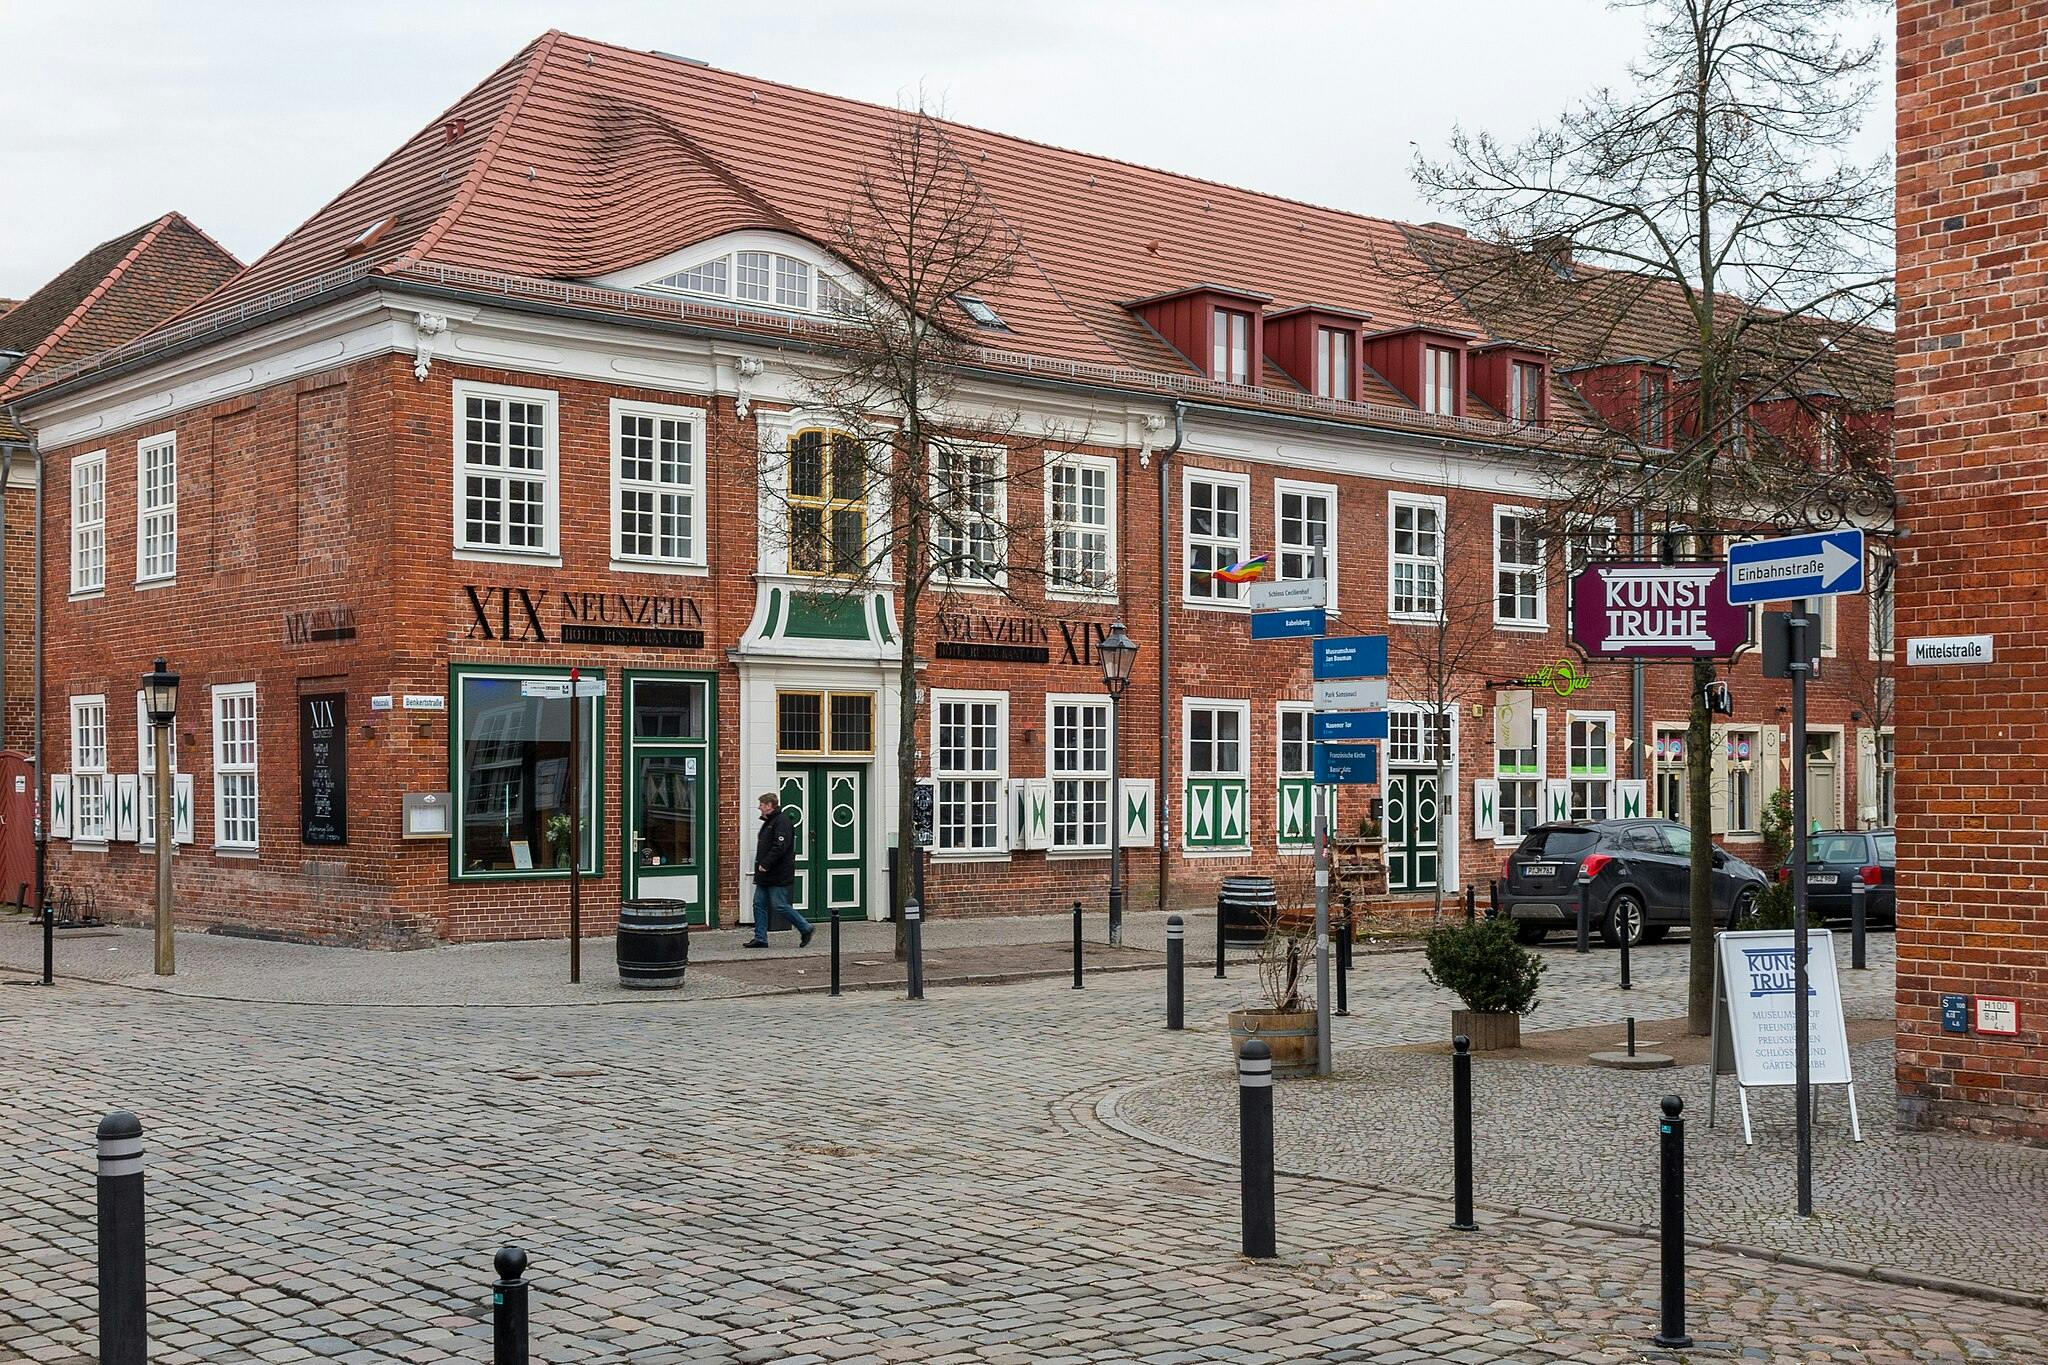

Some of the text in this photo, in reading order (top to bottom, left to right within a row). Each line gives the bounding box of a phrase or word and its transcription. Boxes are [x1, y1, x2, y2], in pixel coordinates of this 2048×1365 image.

[1738, 560, 1825, 581] Einbahnstraße
[1606, 580, 1711, 608] KUNST
[463, 585, 703, 643] XIX NEUNZEHN
[1285, 619, 1310, 627] Babelsberg
[1605, 610, 1707, 638] TRUHE
[939, 612, 1048, 644] NEUNZEHN
[1915, 641, 1982, 660] Mittelstraße
[310, 700, 335, 729] XIX
[1747, 955, 1797, 972] KUNS
[1750, 973, 1797, 990] TRUH
[1942, 999, 1949, 1008] S
